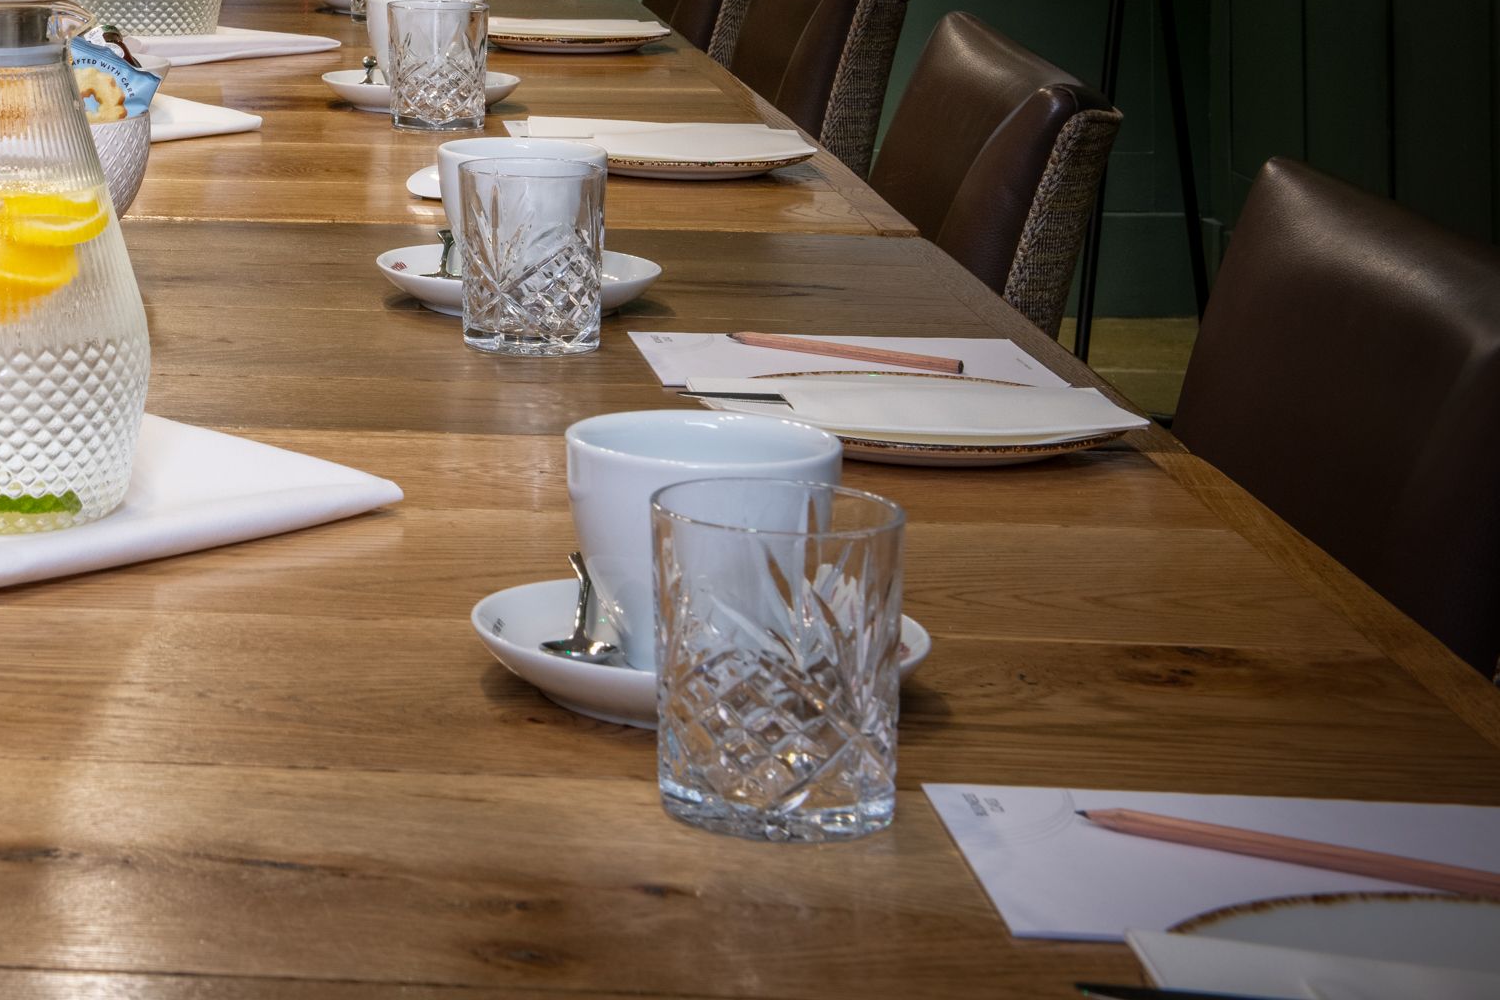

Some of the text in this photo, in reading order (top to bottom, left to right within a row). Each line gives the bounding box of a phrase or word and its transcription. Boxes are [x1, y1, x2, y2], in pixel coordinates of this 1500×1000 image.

[71, 58, 135, 98] AFTED WITH CARE
